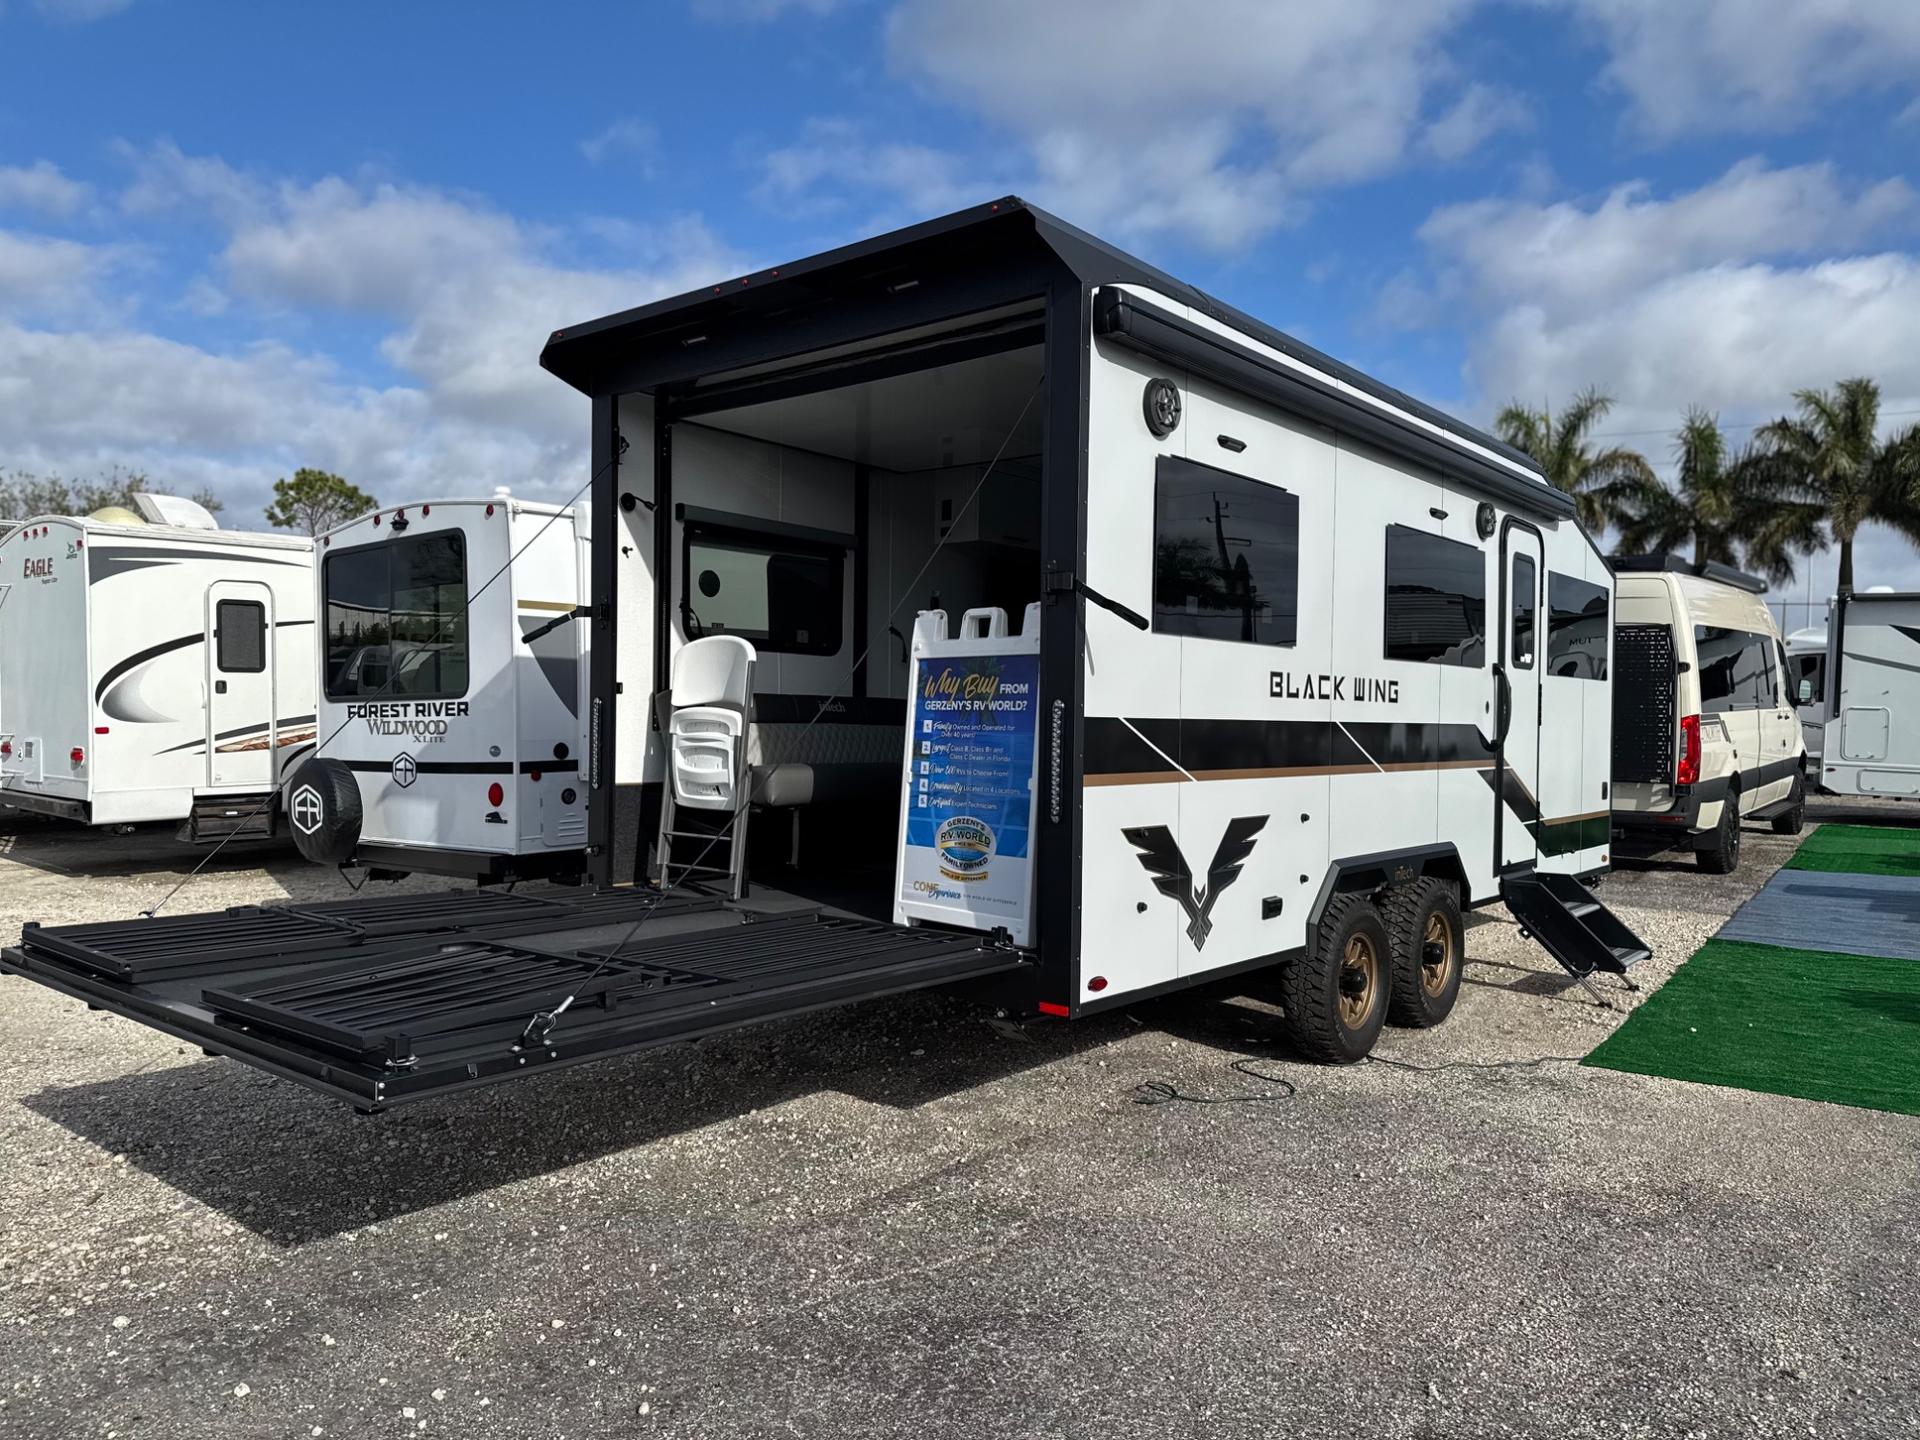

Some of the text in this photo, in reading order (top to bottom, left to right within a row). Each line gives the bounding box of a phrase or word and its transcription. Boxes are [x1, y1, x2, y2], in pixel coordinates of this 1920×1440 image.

[24, 557, 53, 579] EAGLE
[924, 668, 1029, 704] Why Buy FROM
[1269, 670, 1399, 704] BLACK WING
[347, 701, 470, 719] FOREST RIVER
[924, 700, 1028, 711] GERZENY'S RV WORLD?
[367, 718, 448, 736] WILDWOOD
[957, 831, 991, 846] WORLD
